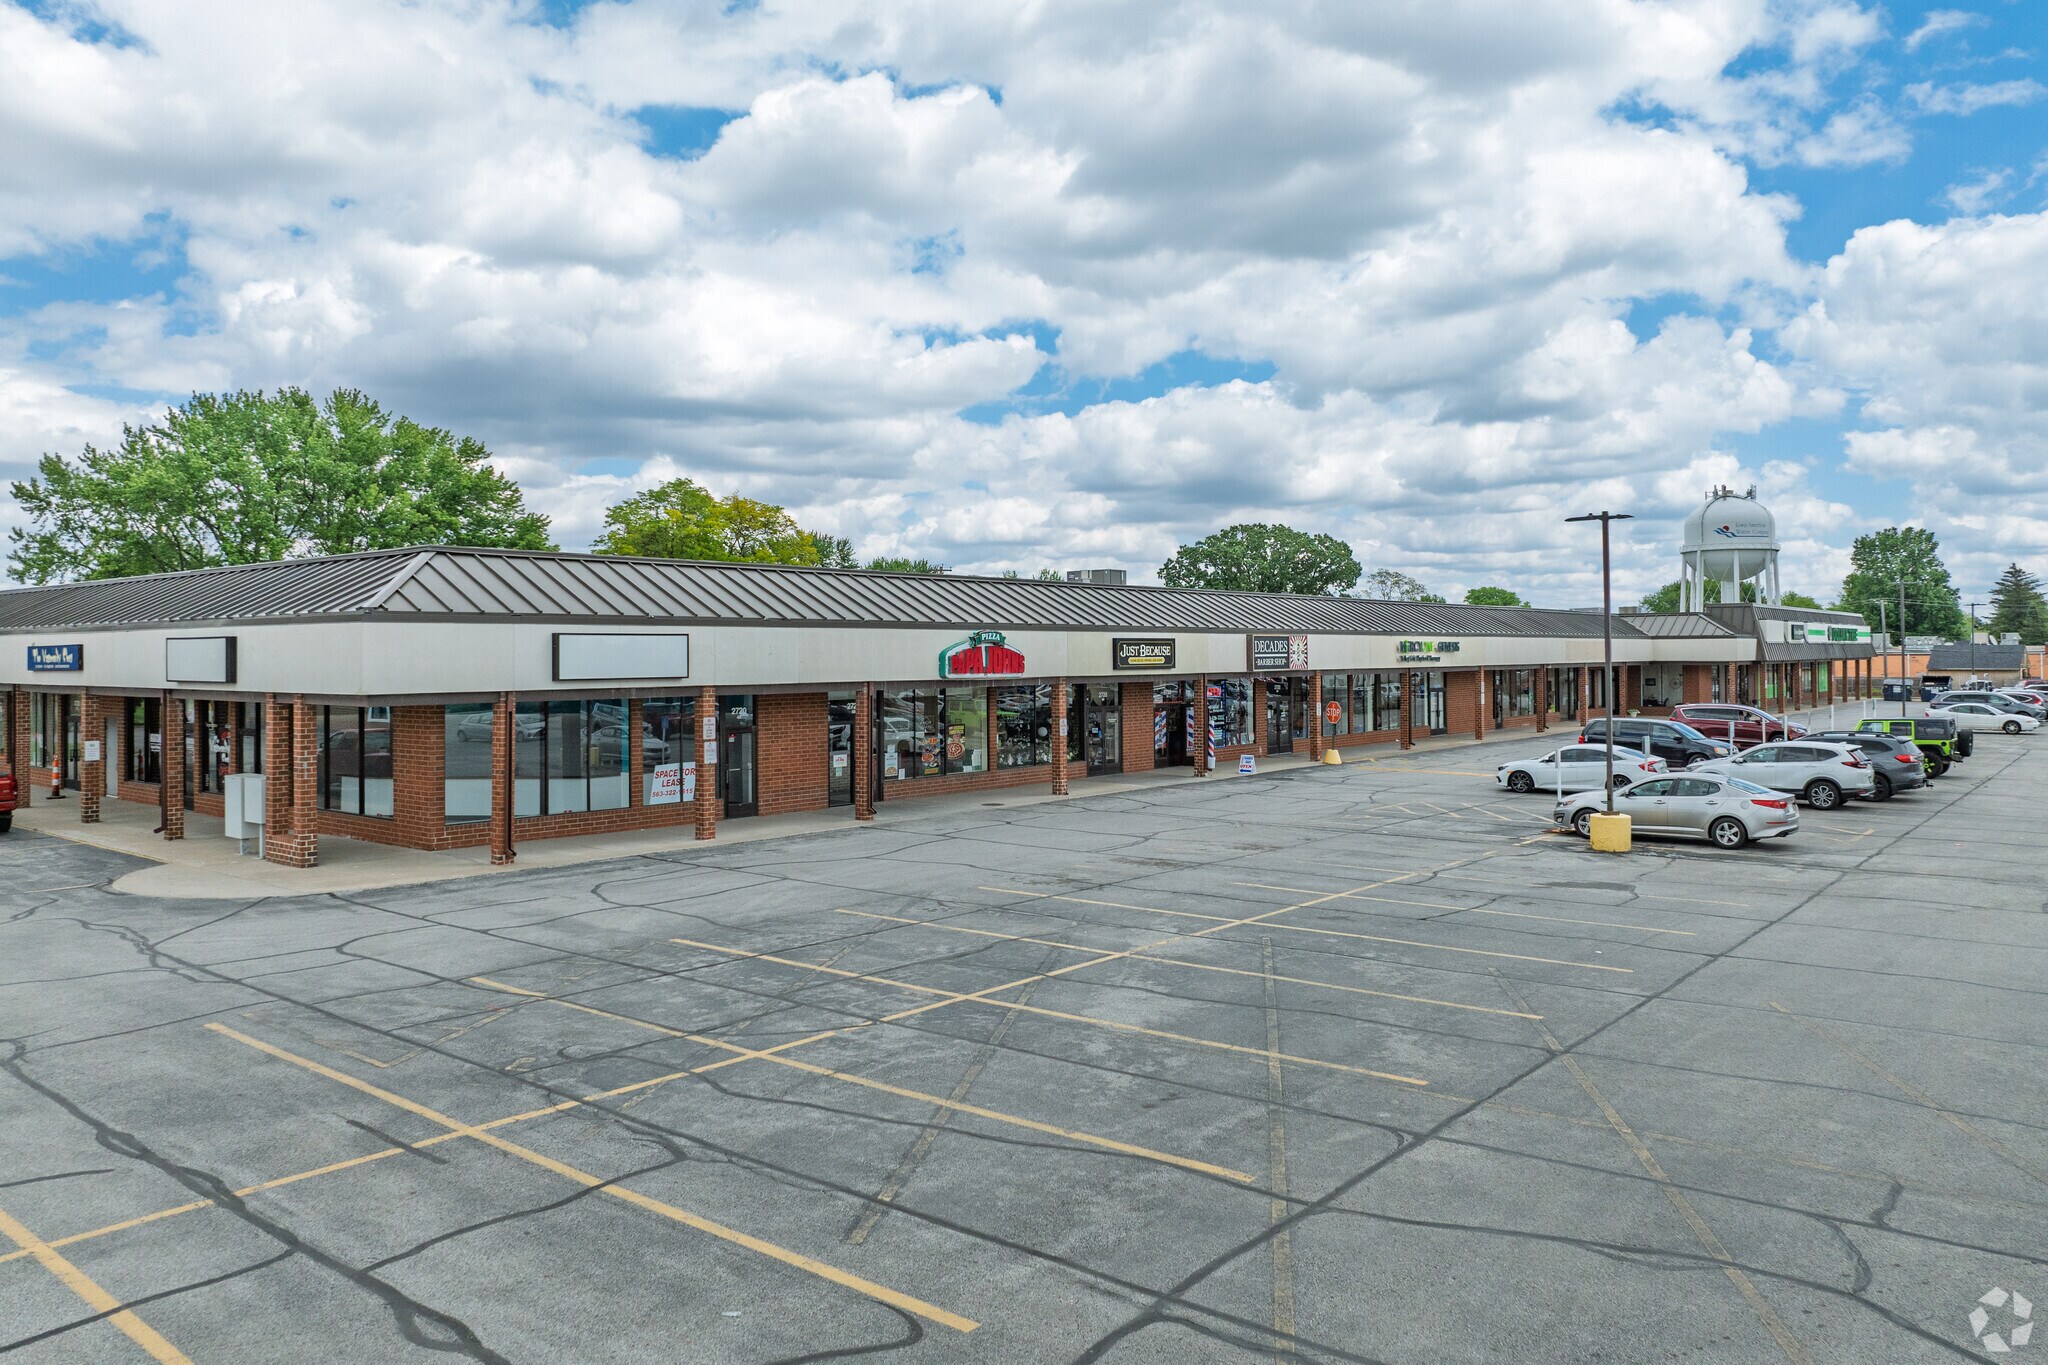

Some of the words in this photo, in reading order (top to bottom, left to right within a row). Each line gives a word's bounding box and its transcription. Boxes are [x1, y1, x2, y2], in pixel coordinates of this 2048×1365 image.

[981, 632, 1000, 641] PIZZA
[1120, 645, 1139, 657] JUST
[1140, 645, 1170, 656] BECAUSE
[1254, 640, 1288, 653] DECADES
[950, 645, 984, 675] PAPA
[1257, 658, 1273, 666] BARBER
[1274, 657, 1285, 665] SHOP
[846, 702, 856, 710] 272
[731, 707, 747, 715] 2720
[1326, 708, 1340, 717] STOP
[655, 769, 678, 779] SPACE
[662, 778, 685, 787] LEASE
